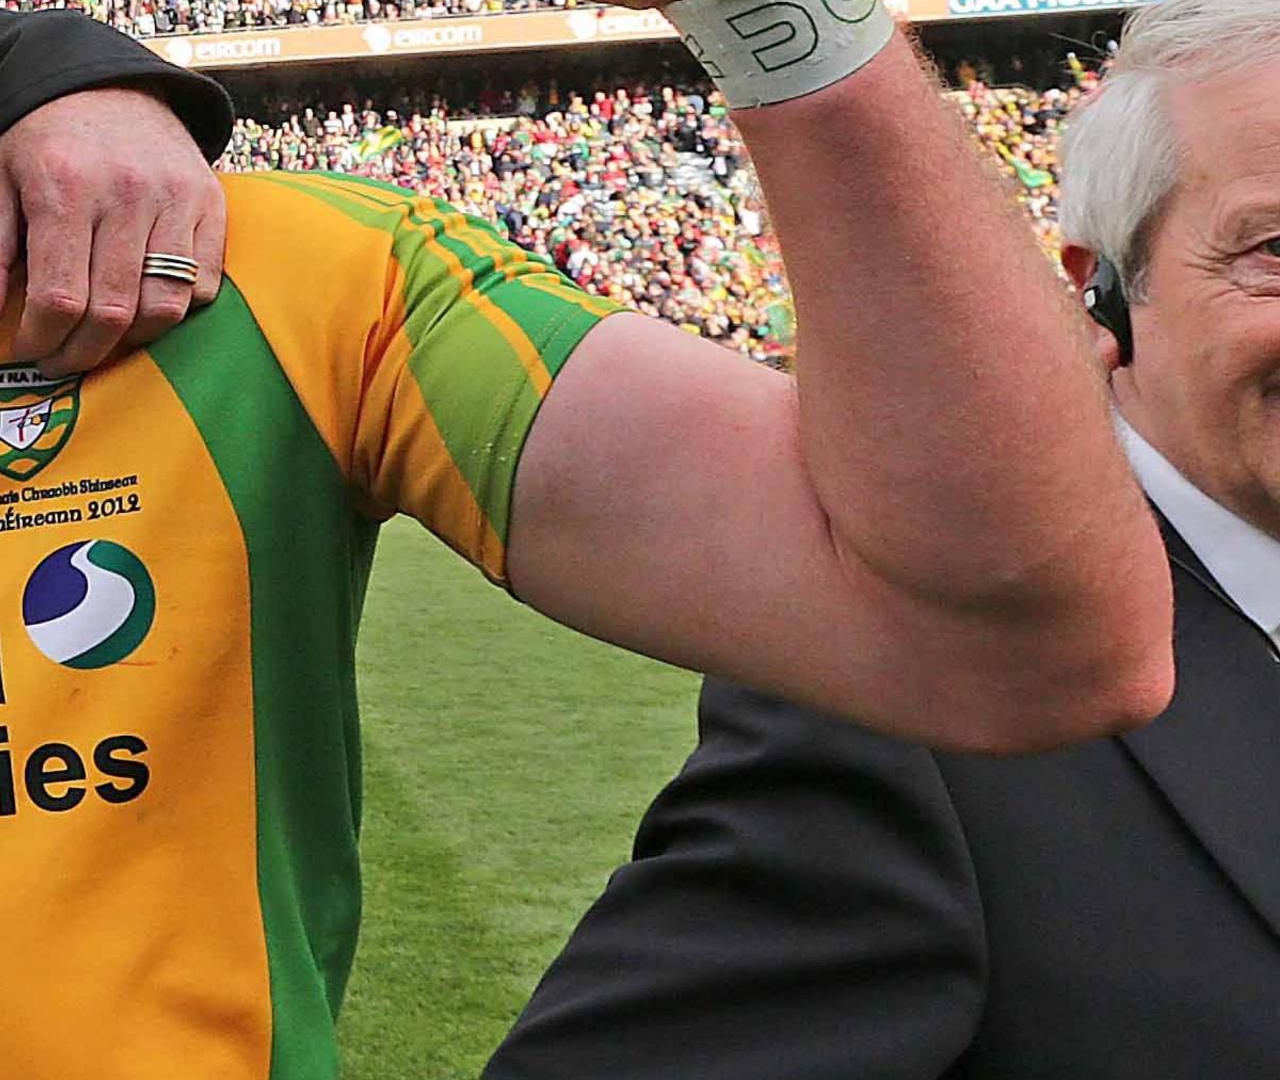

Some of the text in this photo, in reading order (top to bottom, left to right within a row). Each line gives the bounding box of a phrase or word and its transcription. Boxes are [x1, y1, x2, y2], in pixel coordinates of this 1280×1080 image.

[394, 25, 482, 47] eircom
[195, 38, 281, 59] eircom
[88, 493, 141, 520] 2012
